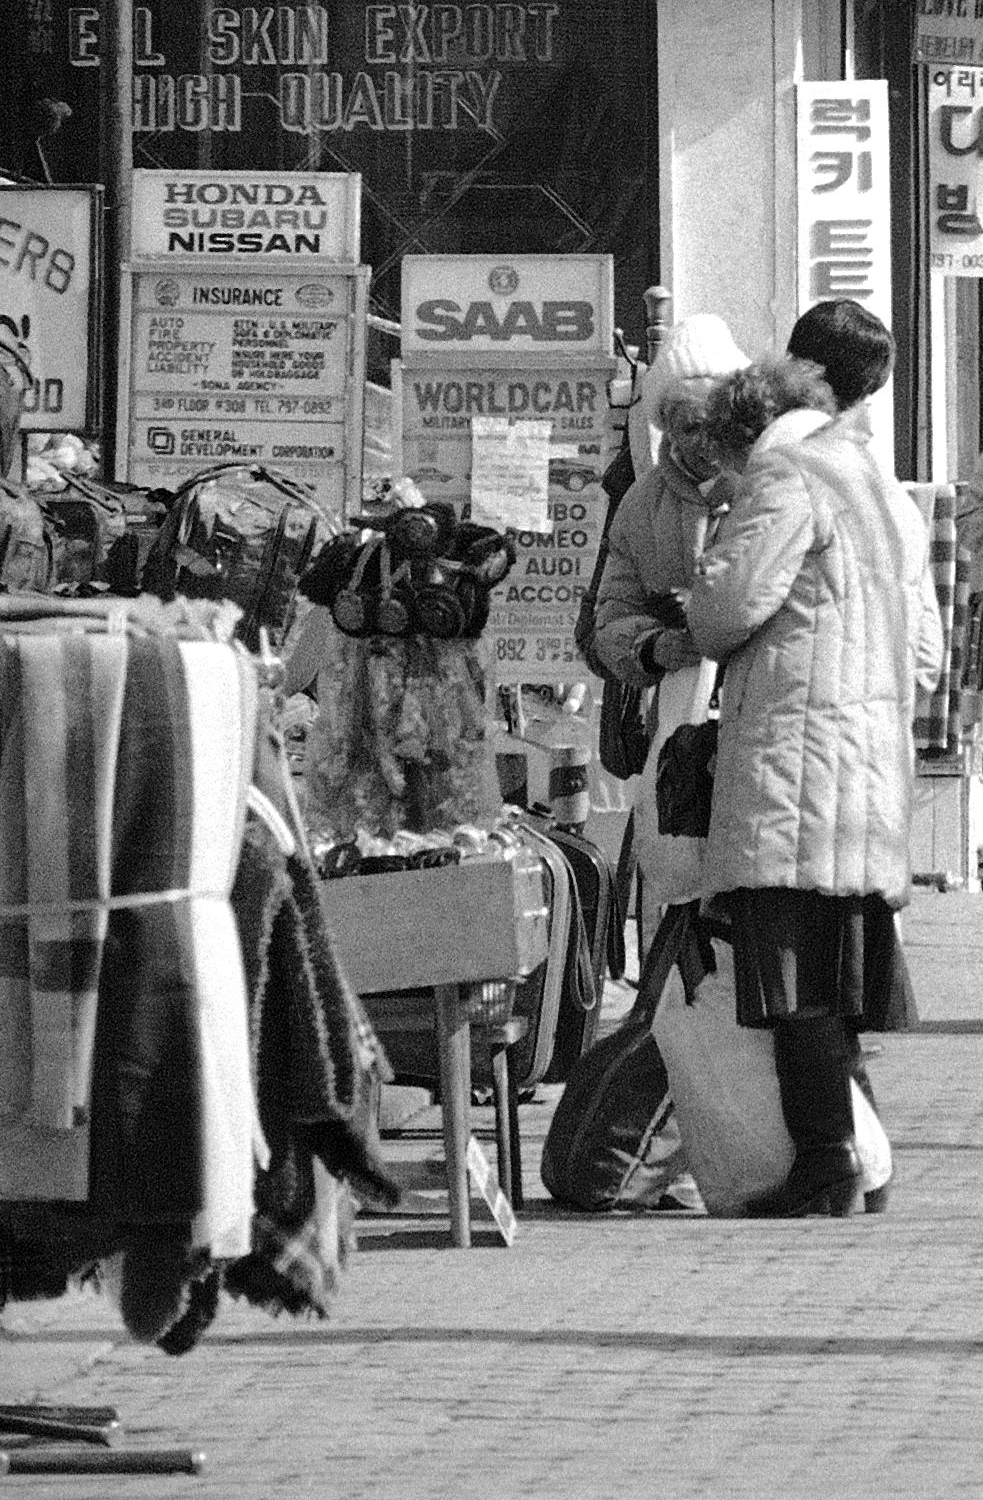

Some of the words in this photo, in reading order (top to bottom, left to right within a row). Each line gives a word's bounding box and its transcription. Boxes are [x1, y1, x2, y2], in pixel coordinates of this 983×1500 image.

[207, 6, 329, 66] SKIN
[365, 3, 560, 64] EXPORT
[132, 73, 241, 131] HIGH
[279, 70, 501, 134] QUALITY
[809, 98, 873, 194] 럭키
[164, 183, 326, 206] HONDA
[163, 208, 327, 229] SUBARU
[168, 232, 320, 253] NISSAN
[192, 287, 283, 306] INSURANCE
[150, 317, 184, 329] AUTO
[414, 299, 595, 341] SAAB
[149, 329, 180, 339] FIRE
[148, 340, 216, 352] PROPERTY
[148, 351, 210, 362] ACCIDENT
[147, 361, 209, 374] LIABILITY
[413, 381, 596, 414] WORLDCAR
[560, 416, 594, 430] SALES
[181, 429, 237, 442] GENERAL
[180, 443, 264, 456] DEVELOPMENT
[272, 445, 335, 458] CORPORATION
[525, 557, 581, 576] AUDI
